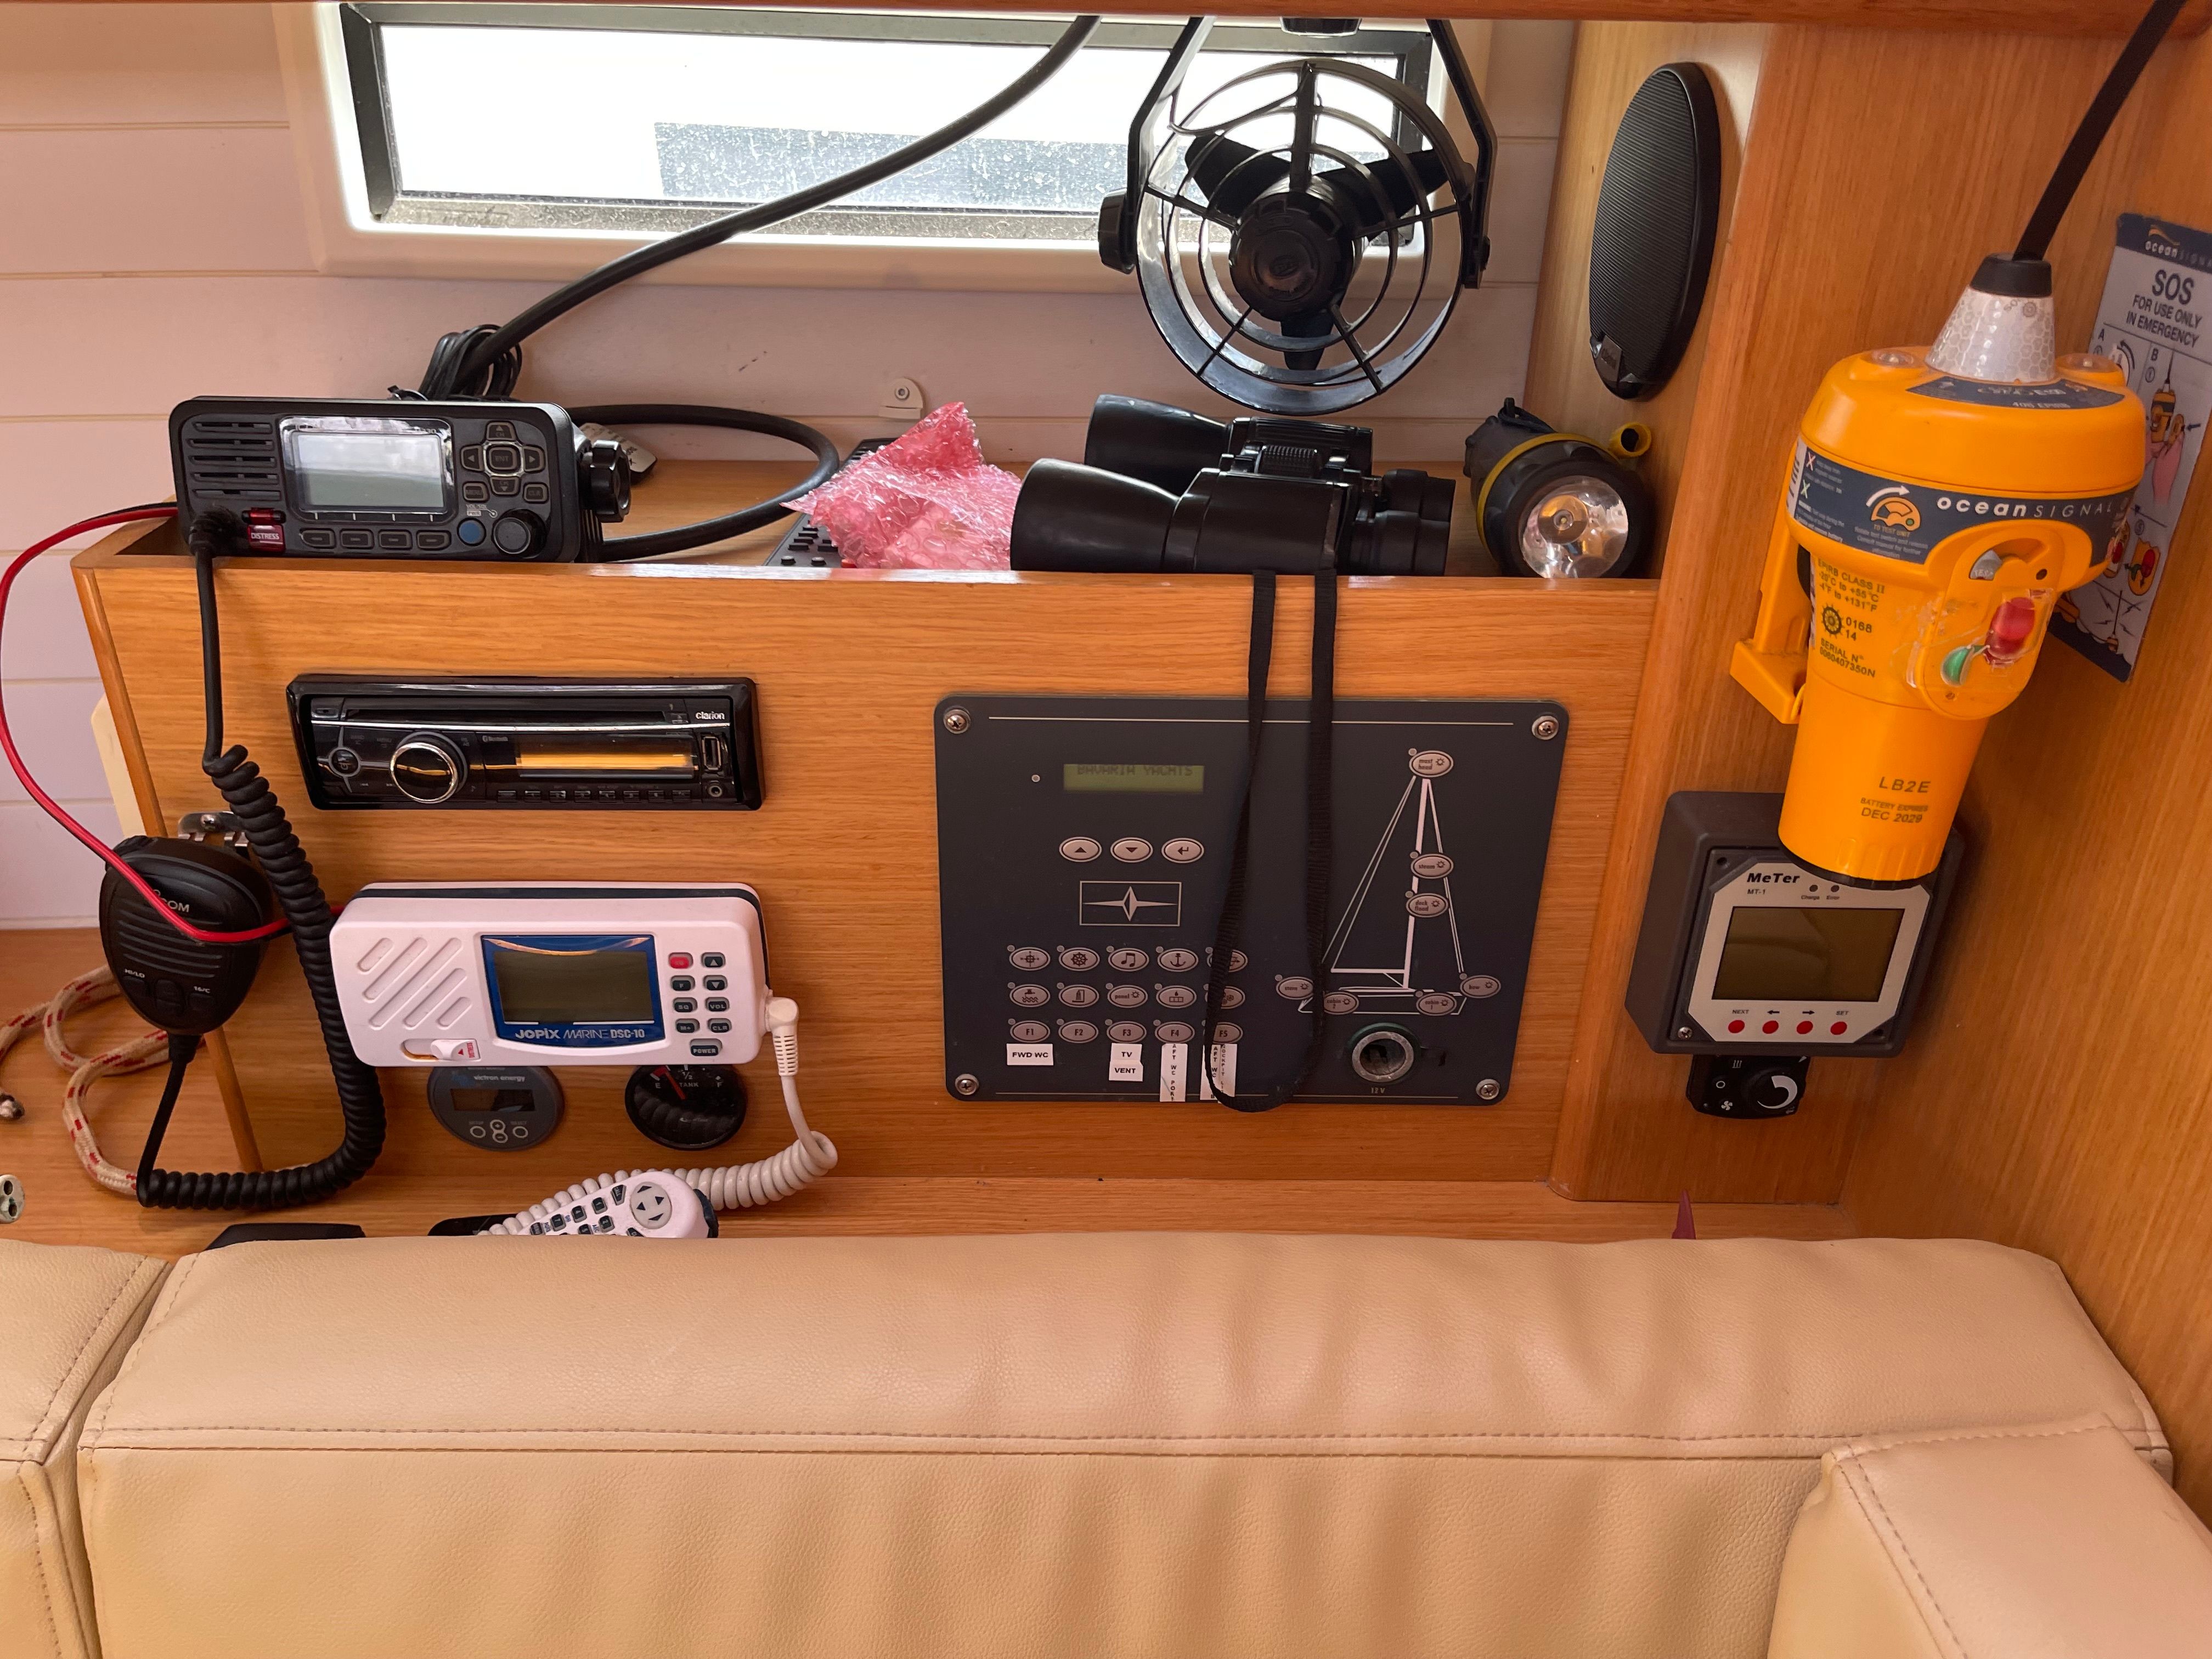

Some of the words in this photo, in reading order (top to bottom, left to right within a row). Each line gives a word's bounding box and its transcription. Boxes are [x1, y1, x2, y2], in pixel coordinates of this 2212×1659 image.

[2152, 269, 2194, 304] SOS
[2132, 294, 2152, 312] FOR
[2154, 302, 2174, 319] USE
[2175, 309, 2203, 329] ONLY
[2098, 329, 2104, 341] A
[2126, 311, 2137, 325] IN
[2137, 315, 2199, 348] EMERGENCY
[2151, 348, 2159, 360] B
[1937, 496, 2027, 517] ocean
[2034, 503, 2112, 517] SIGNAL
[1842, 572, 1873, 590] CLASS
[1846, 617, 1872, 633] 0168
[1846, 629, 1857, 641] 14
[1821, 638, 1847, 659] SERIAL
[695, 711, 725, 720] clarion
[1878, 776, 1931, 793] LB2E
[1860, 797, 1895, 809] BATTERY
[1861, 807, 1889, 820] DEC
[1747, 873, 1800, 883] MeTer
[563, 1030, 608, 1039] MARINE
[611, 1029, 645, 1039] DSC-10
